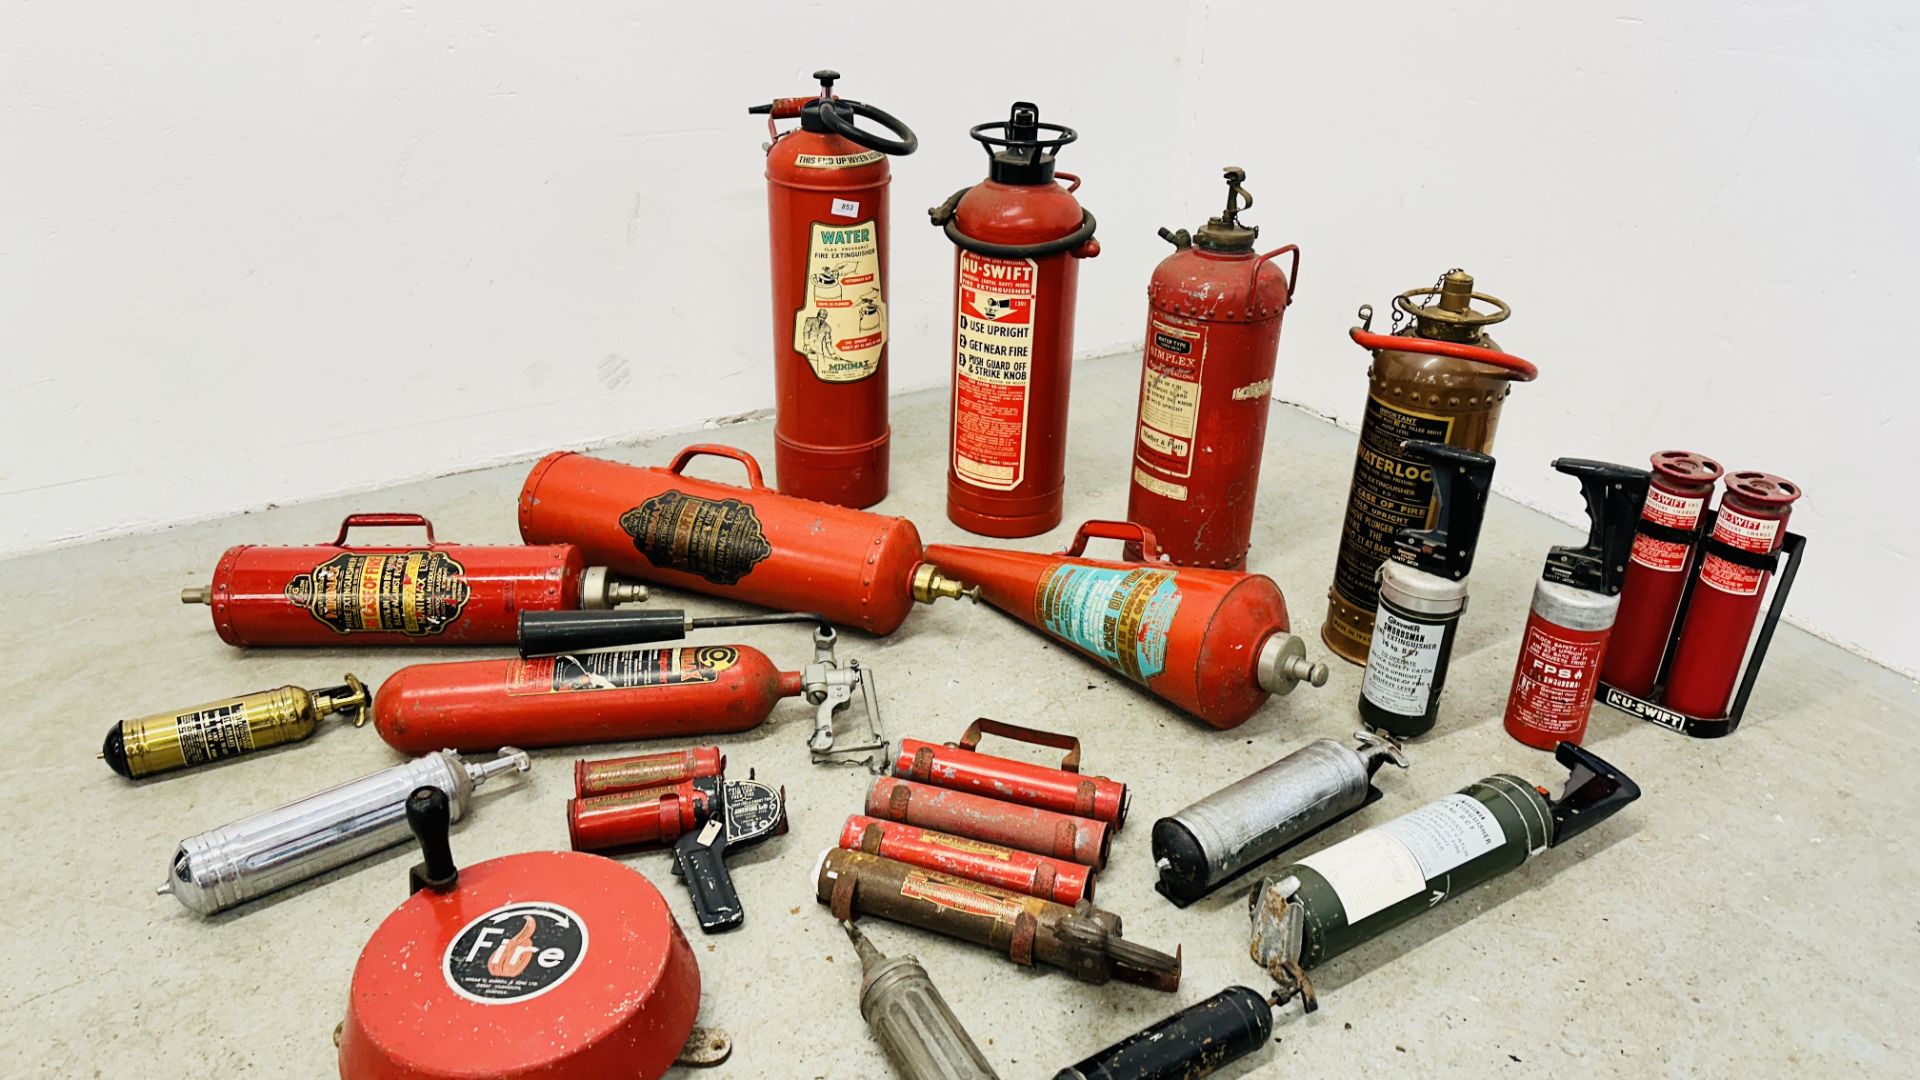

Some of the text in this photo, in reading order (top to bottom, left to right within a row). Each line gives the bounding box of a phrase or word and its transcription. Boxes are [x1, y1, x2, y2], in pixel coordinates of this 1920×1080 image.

[799, 156, 815, 164] THIS
[821, 228, 870, 244] WATER
[831, 248, 875, 259] EXTINGUISHER
[977, 283, 1030, 294] EXTINGUISHER
[970, 320, 984, 333] USE
[987, 325, 1029, 338] UPRIGHT
[969, 340, 983, 352] GET
[984, 343, 1006, 356] NEAR
[1008, 346, 1028, 356] FIRE
[1158, 335, 1186, 348] WATER TYPE
[829, 360, 869, 370] MINIMAX
[969, 354, 984, 366] PUSH
[986, 359, 1010, 370] GUARD
[1014, 362, 1027, 371] OFF
[1150, 346, 1196, 368] SIMPLEX
[975, 366, 1000, 379] STRIKE
[1004, 371, 1027, 380] KNOB
[1380, 407, 1418, 424] IMPORTANT
[1368, 476, 1415, 496] EXTINGUISHER
[1357, 488, 1425, 516] CASE OF FIRE
[1372, 508, 1409, 524] UPRIGHT
[1365, 516, 1393, 533] PLUNGER
[1370, 530, 1382, 542] THE
[1374, 544, 1392, 555] BASE
[343, 557, 357, 610] EXTINGUISHER
[392, 577, 400, 606] AGAINST
[362, 557, 384, 627] IN CASE OF FIRE
[1108, 591, 1126, 610] OF
[1103, 615, 1117, 652] CASE
[1384, 622, 1425, 642] SWORDSMAN
[1387, 633, 1436, 649] EXTINGUISHER
[1554, 642, 1578, 651] SAFETY
[1388, 661, 1410, 671] SAFETY
[1389, 655, 1416, 667] OPERATE
[1533, 659, 1572, 679] FPS
[1385, 674, 1399, 682] BASE
[1390, 669, 1417, 679] UPRIGHT
[466, 927, 565, 968] Fire
